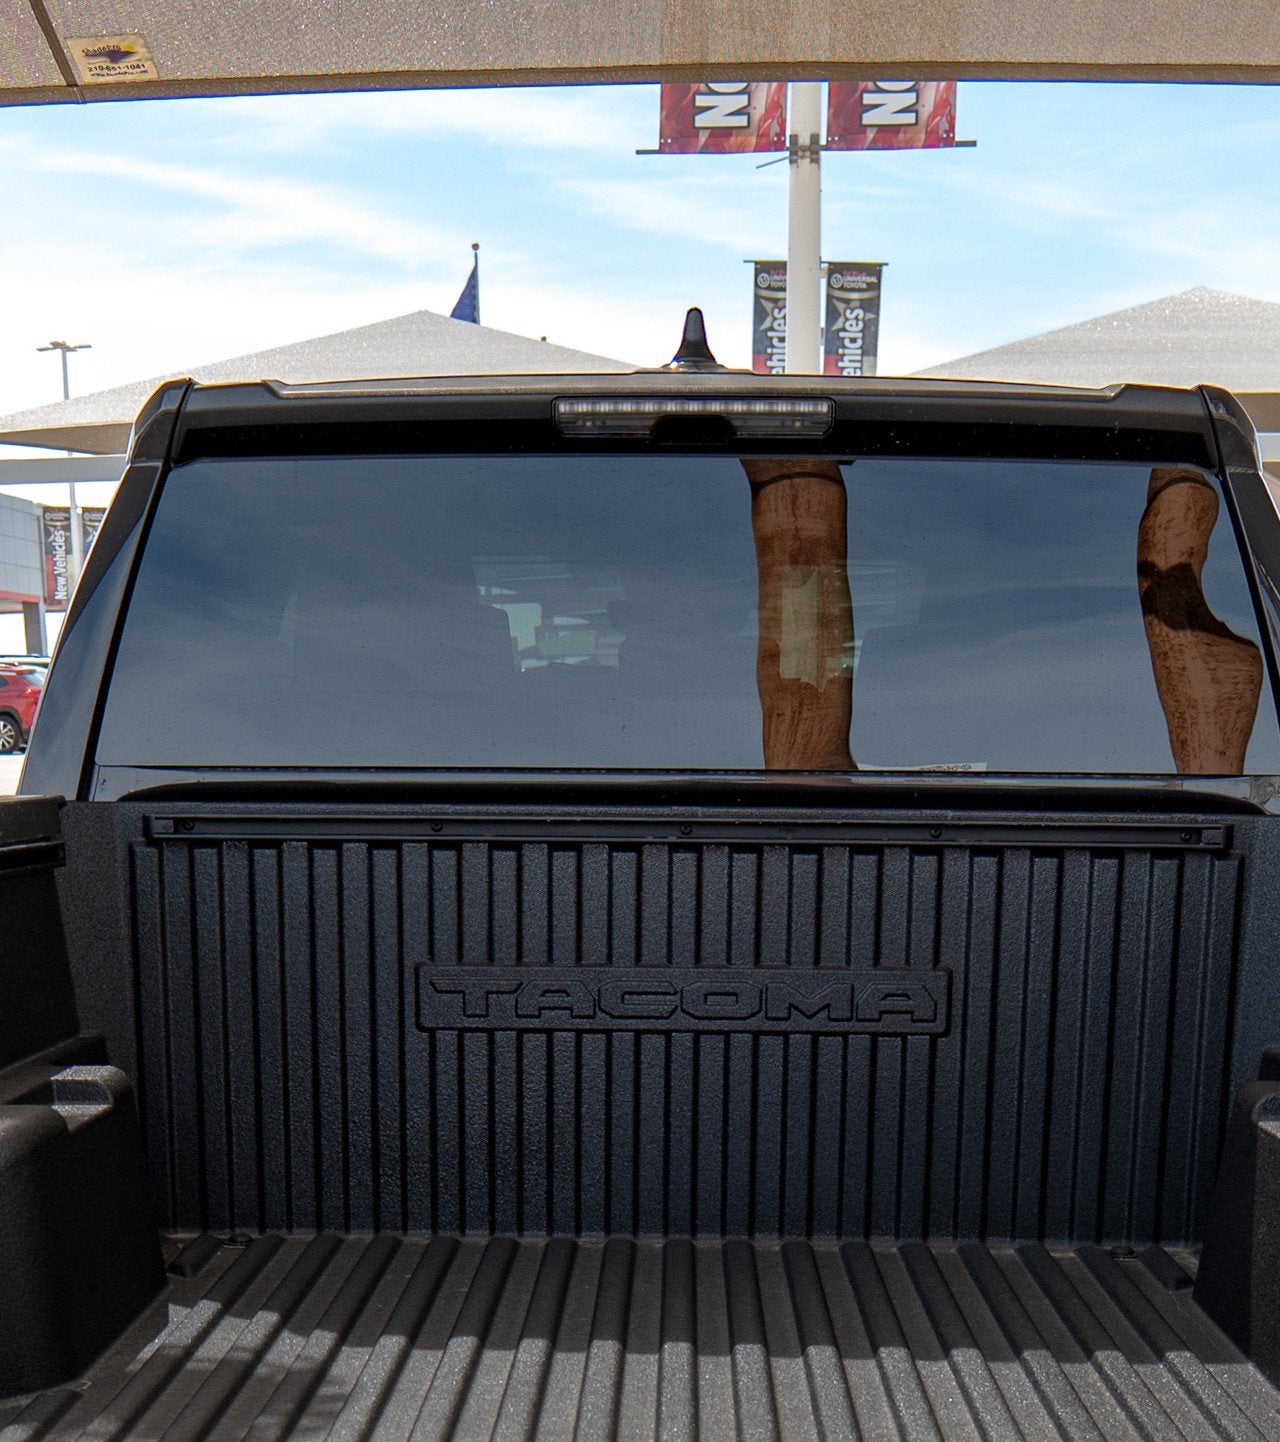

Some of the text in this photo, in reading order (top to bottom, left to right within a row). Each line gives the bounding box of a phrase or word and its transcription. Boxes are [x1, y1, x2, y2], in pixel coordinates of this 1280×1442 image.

[52, 530, 66, 575] Vehicles
[55, 576, 68, 600] New
[429, 979, 938, 1023] TACOMA
